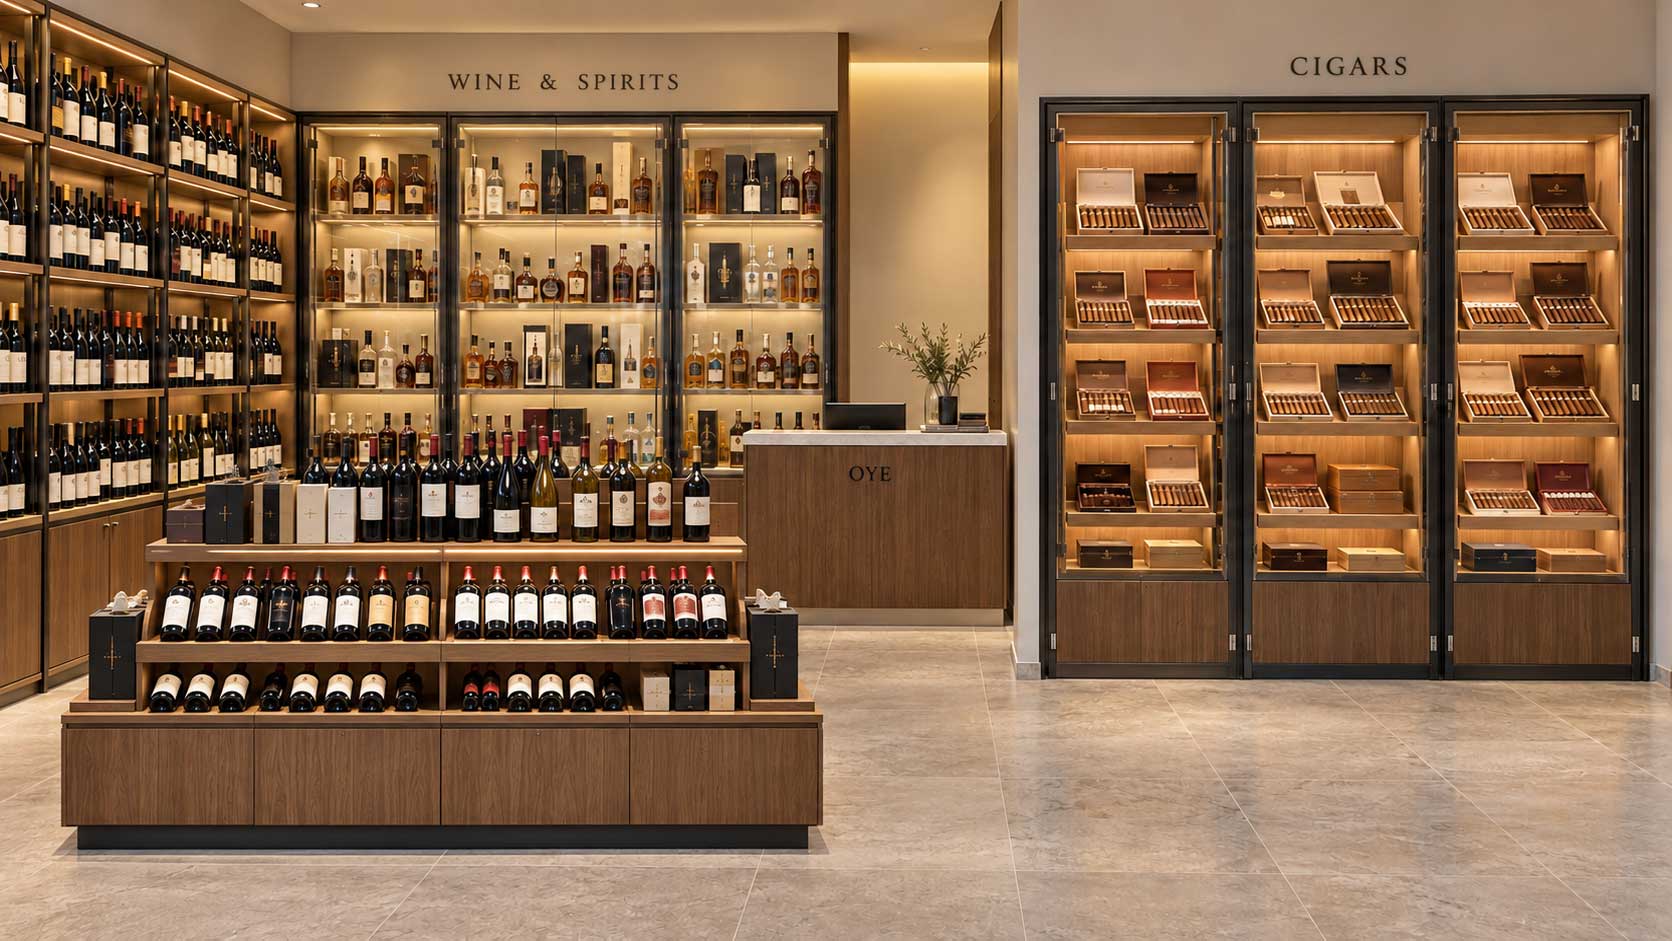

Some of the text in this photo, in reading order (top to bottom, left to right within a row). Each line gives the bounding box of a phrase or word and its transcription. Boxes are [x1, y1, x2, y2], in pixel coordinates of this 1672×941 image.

[1290, 56, 1408, 77] CIGARS
[448, 73, 679, 91] WINE & SPIRITS
[848, 465, 892, 483] OYE
